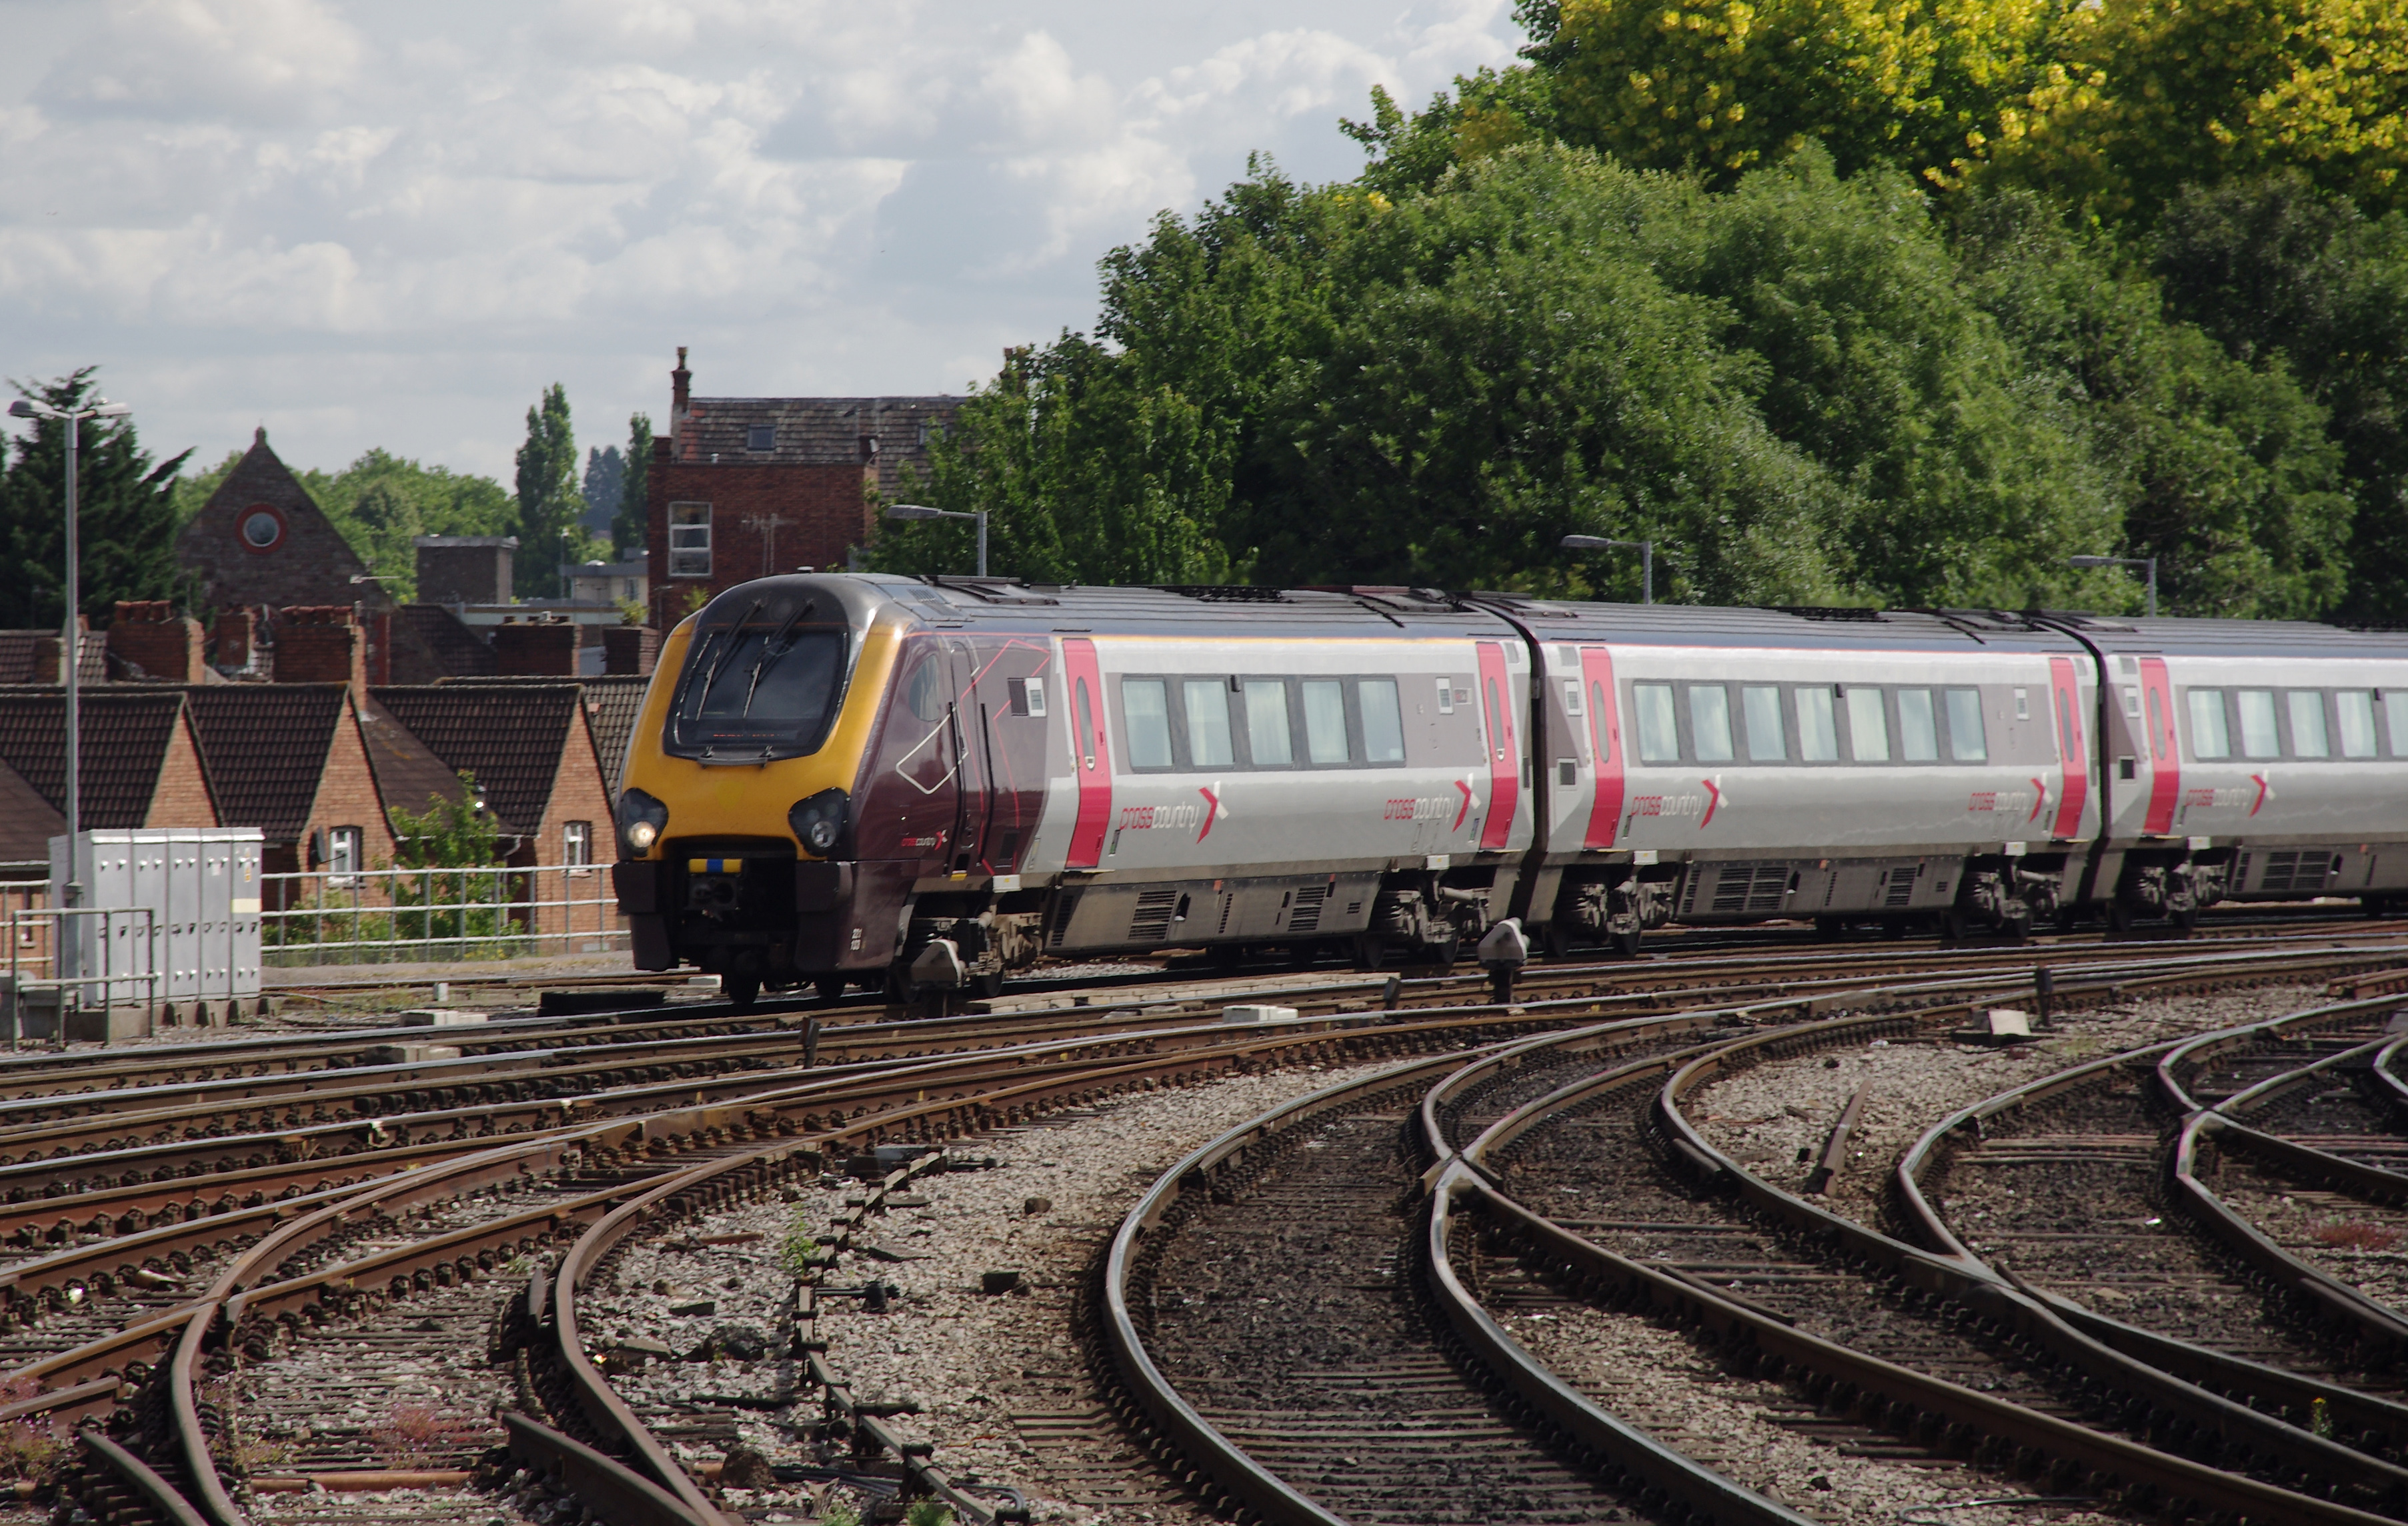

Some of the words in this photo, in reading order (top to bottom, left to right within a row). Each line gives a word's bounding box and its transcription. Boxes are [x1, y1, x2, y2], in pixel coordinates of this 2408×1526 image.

[1120, 801, 1199, 834] crosscountry
[1384, 793, 1455, 823] crosscountry
[1631, 791, 1701, 821] crosscountry
